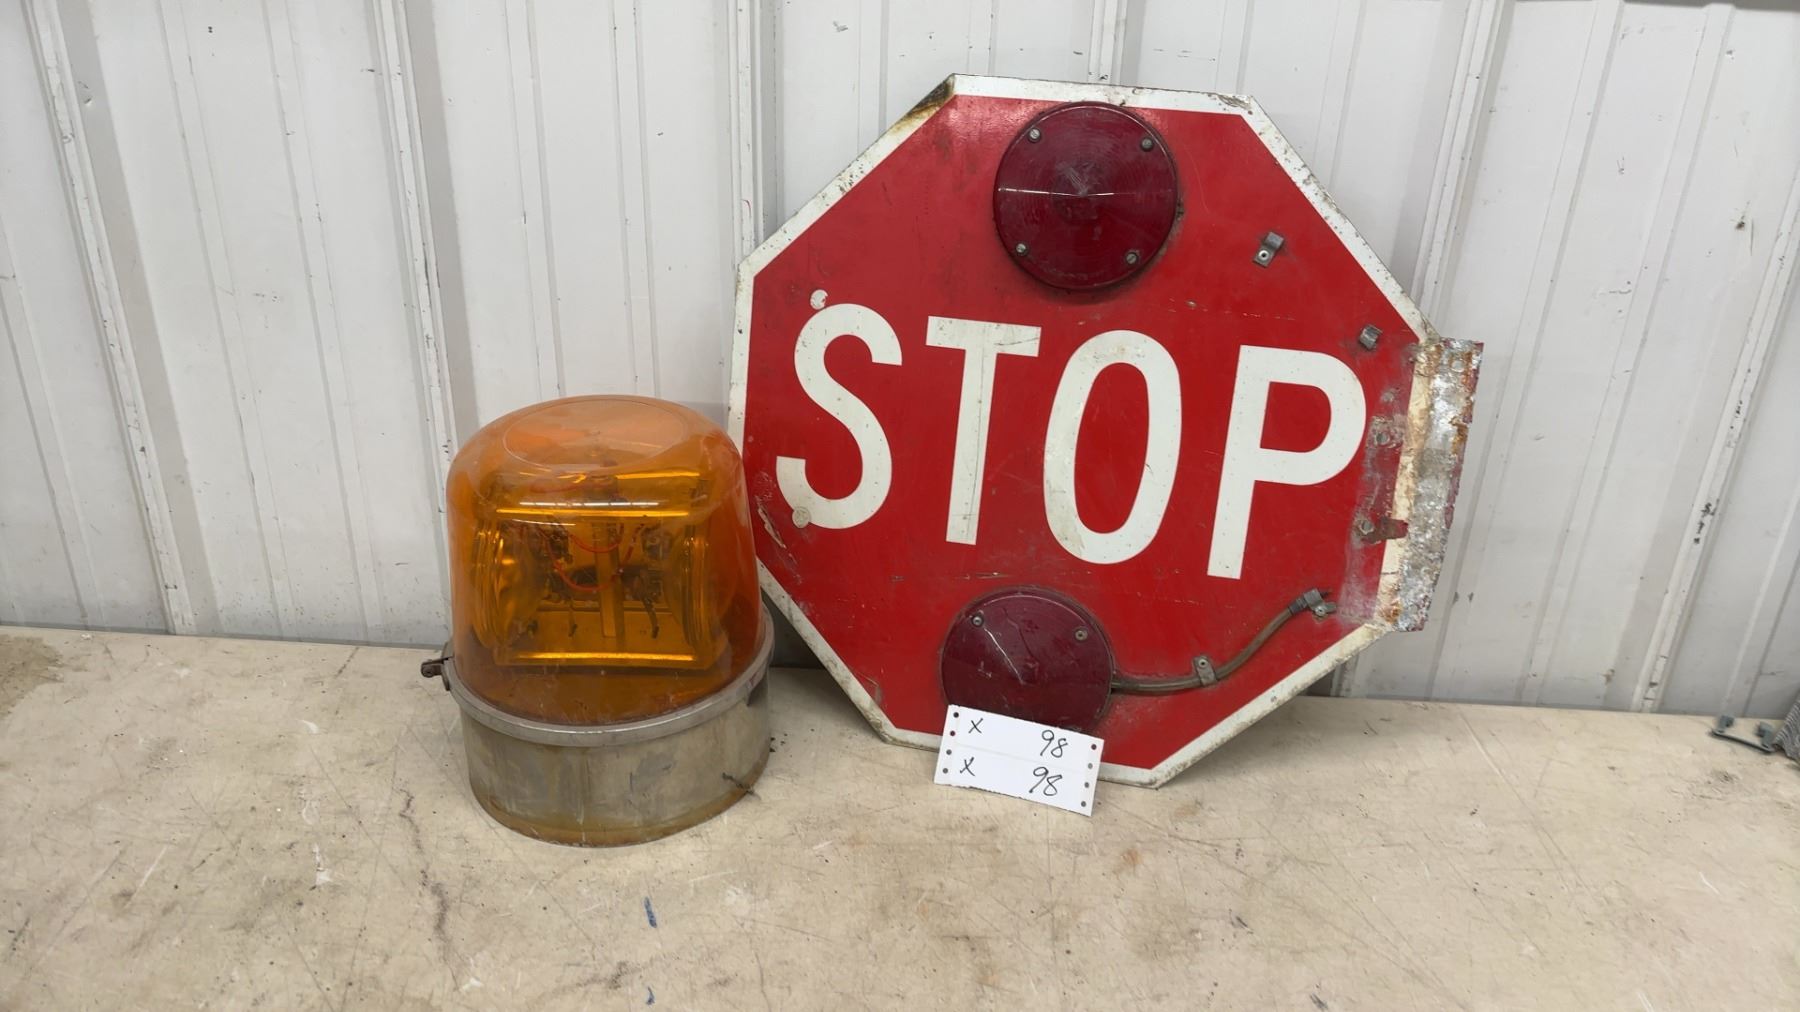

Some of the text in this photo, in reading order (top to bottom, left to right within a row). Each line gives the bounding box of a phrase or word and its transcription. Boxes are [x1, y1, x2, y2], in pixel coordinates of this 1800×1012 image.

[776, 303, 1368, 579] STOP
[1040, 729, 1068, 758] 98
[1028, 766, 1063, 796] 98
